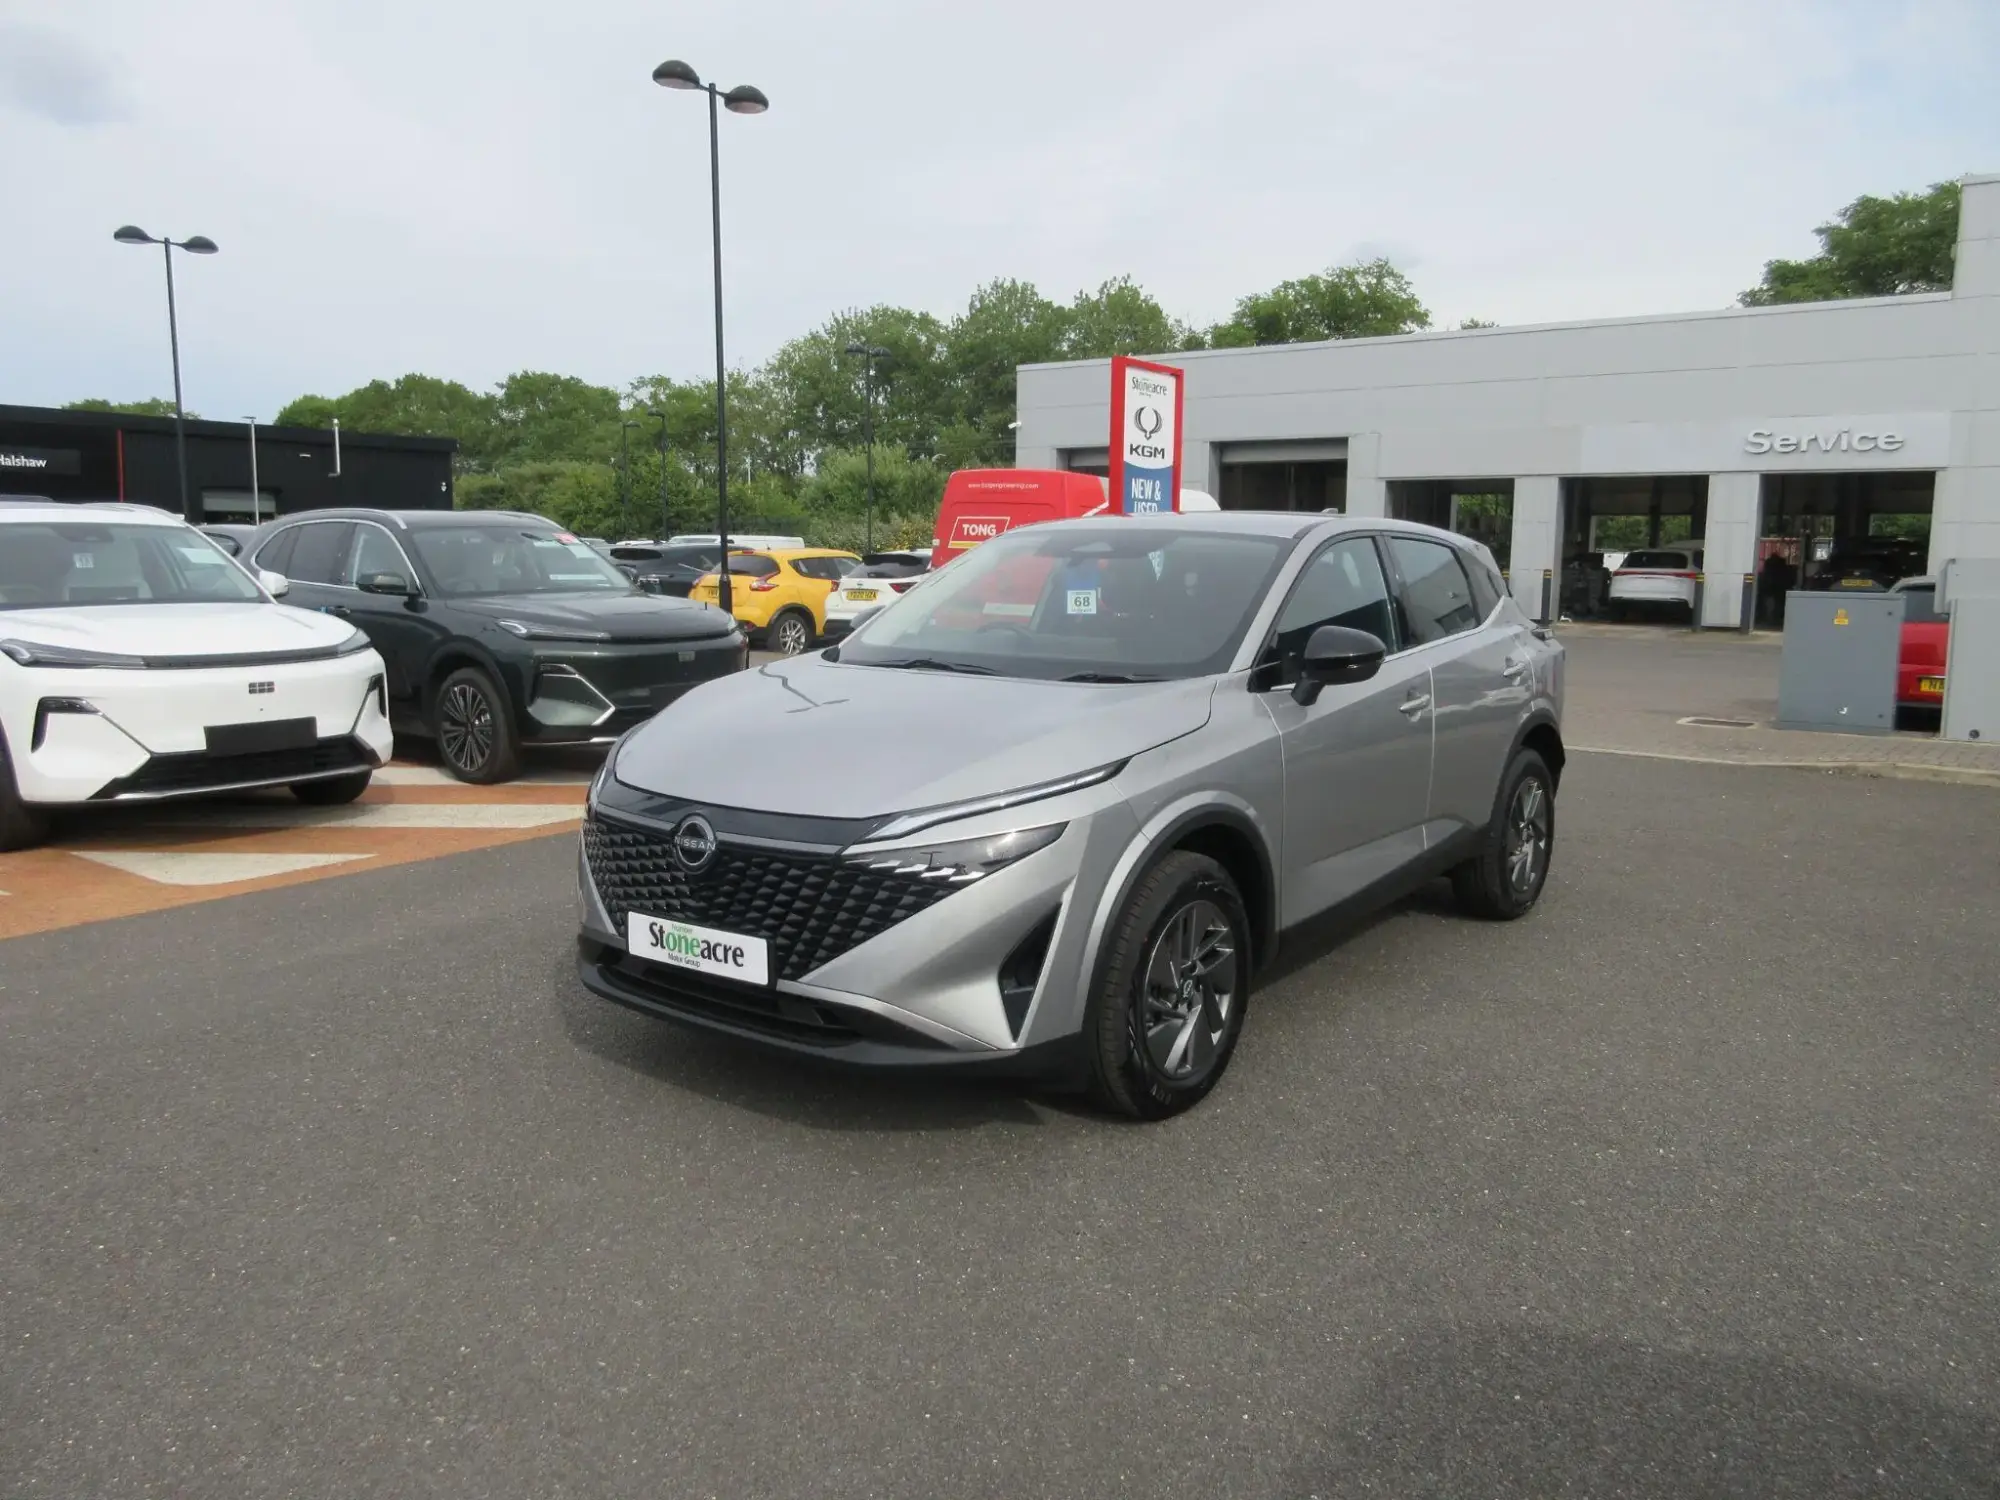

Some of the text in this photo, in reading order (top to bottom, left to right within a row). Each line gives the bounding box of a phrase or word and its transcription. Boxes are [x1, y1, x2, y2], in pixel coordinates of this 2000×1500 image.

[1132, 376, 1167, 396] Stoneacre
[1744, 427, 1905, 455] Service
[1129, 443, 1165, 459] KGM
[1131, 478, 1162, 501] NEW &
[962, 524, 997, 536] TONG
[1074, 596, 1090, 607] 68
[674, 836, 716, 851] NISSAN
[648, 922, 745, 968] Stoneacre
